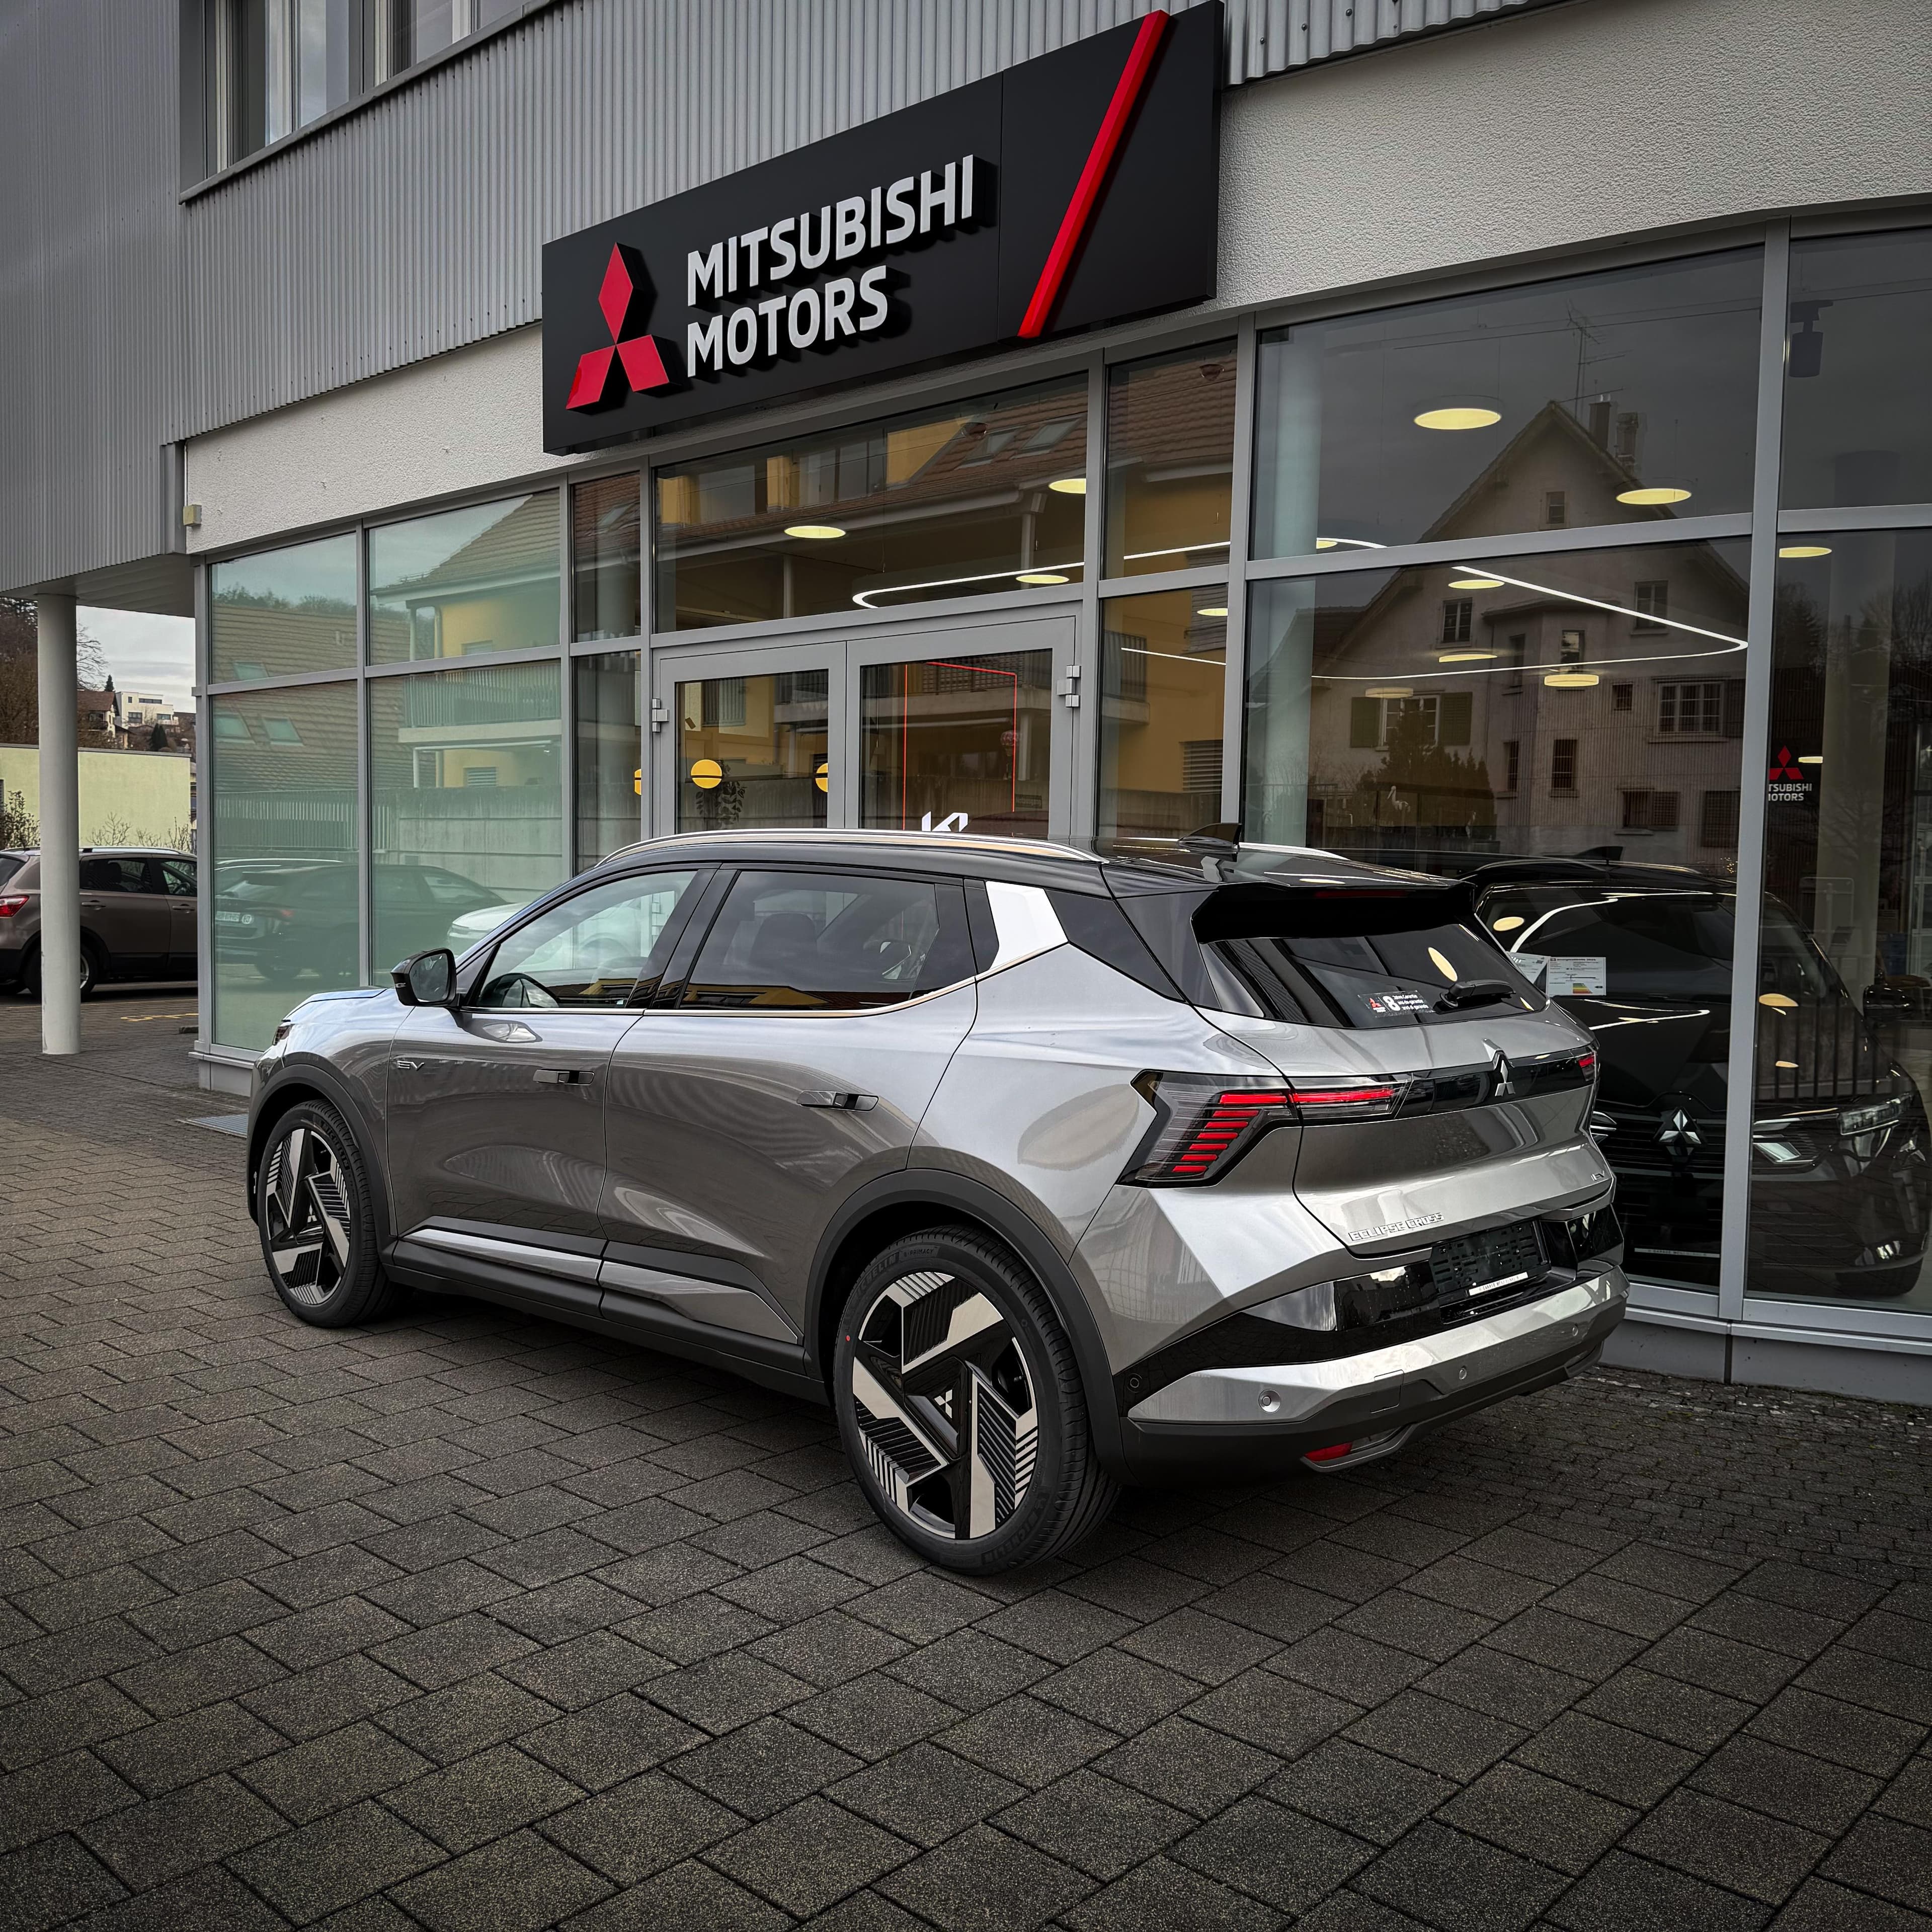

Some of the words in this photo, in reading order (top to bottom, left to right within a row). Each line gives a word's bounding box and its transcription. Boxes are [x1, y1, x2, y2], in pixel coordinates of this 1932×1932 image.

[688, 154, 974, 306] MITSUBISHI
[688, 265, 887, 377] MOTORS
[1768, 783, 1812, 792] TSUBISHI
[1768, 793, 1804, 801] OTORS
[1383, 995, 1400, 1011] 8
[397, 1061, 425, 1070] EV
[1591, 1170, 1604, 1181] EV
[1348, 1222, 1406, 1241] ECLIPSE
[1405, 1213, 1444, 1229] CROSS
